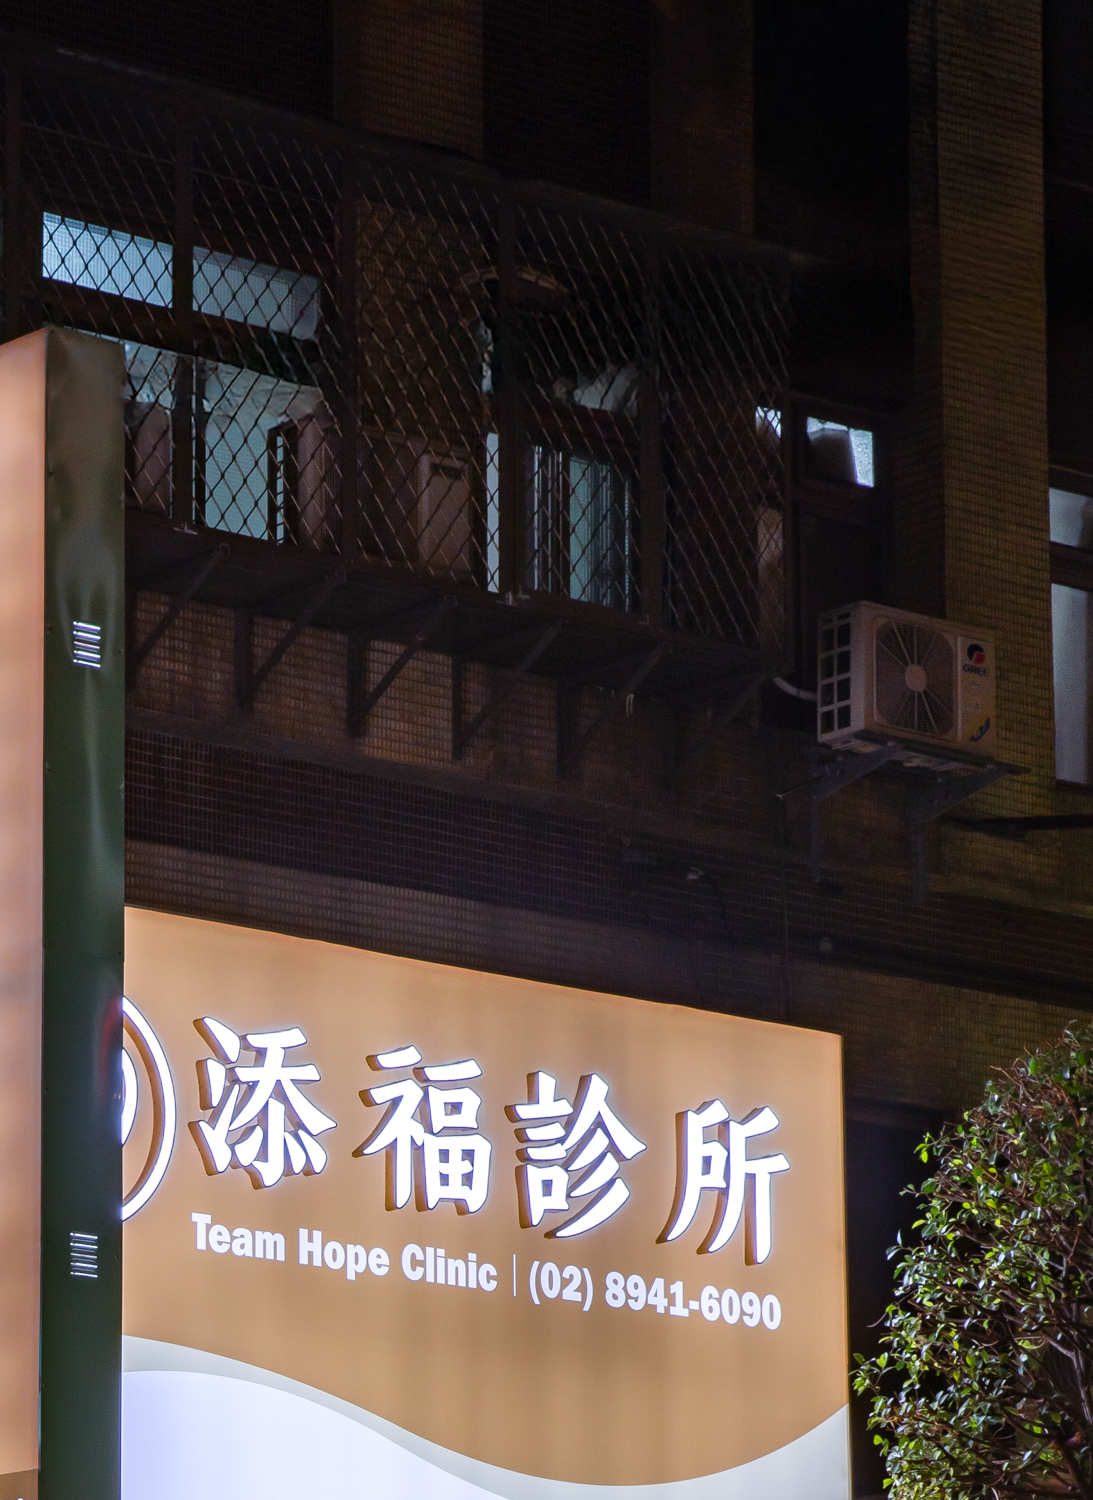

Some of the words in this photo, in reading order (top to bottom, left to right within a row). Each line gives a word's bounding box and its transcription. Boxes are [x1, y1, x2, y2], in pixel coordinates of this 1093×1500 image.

[962, 663, 988, 677] GREE
[188, 1016, 790, 1265] 添福診所
[192, 1212, 285, 1262] Team
[298, 1230, 390, 1280] Hope
[401, 1243, 499, 1292] Clinic
[528, 1262, 595, 1312] (02)
[605, 1276, 783, 1331] 8941-6090
